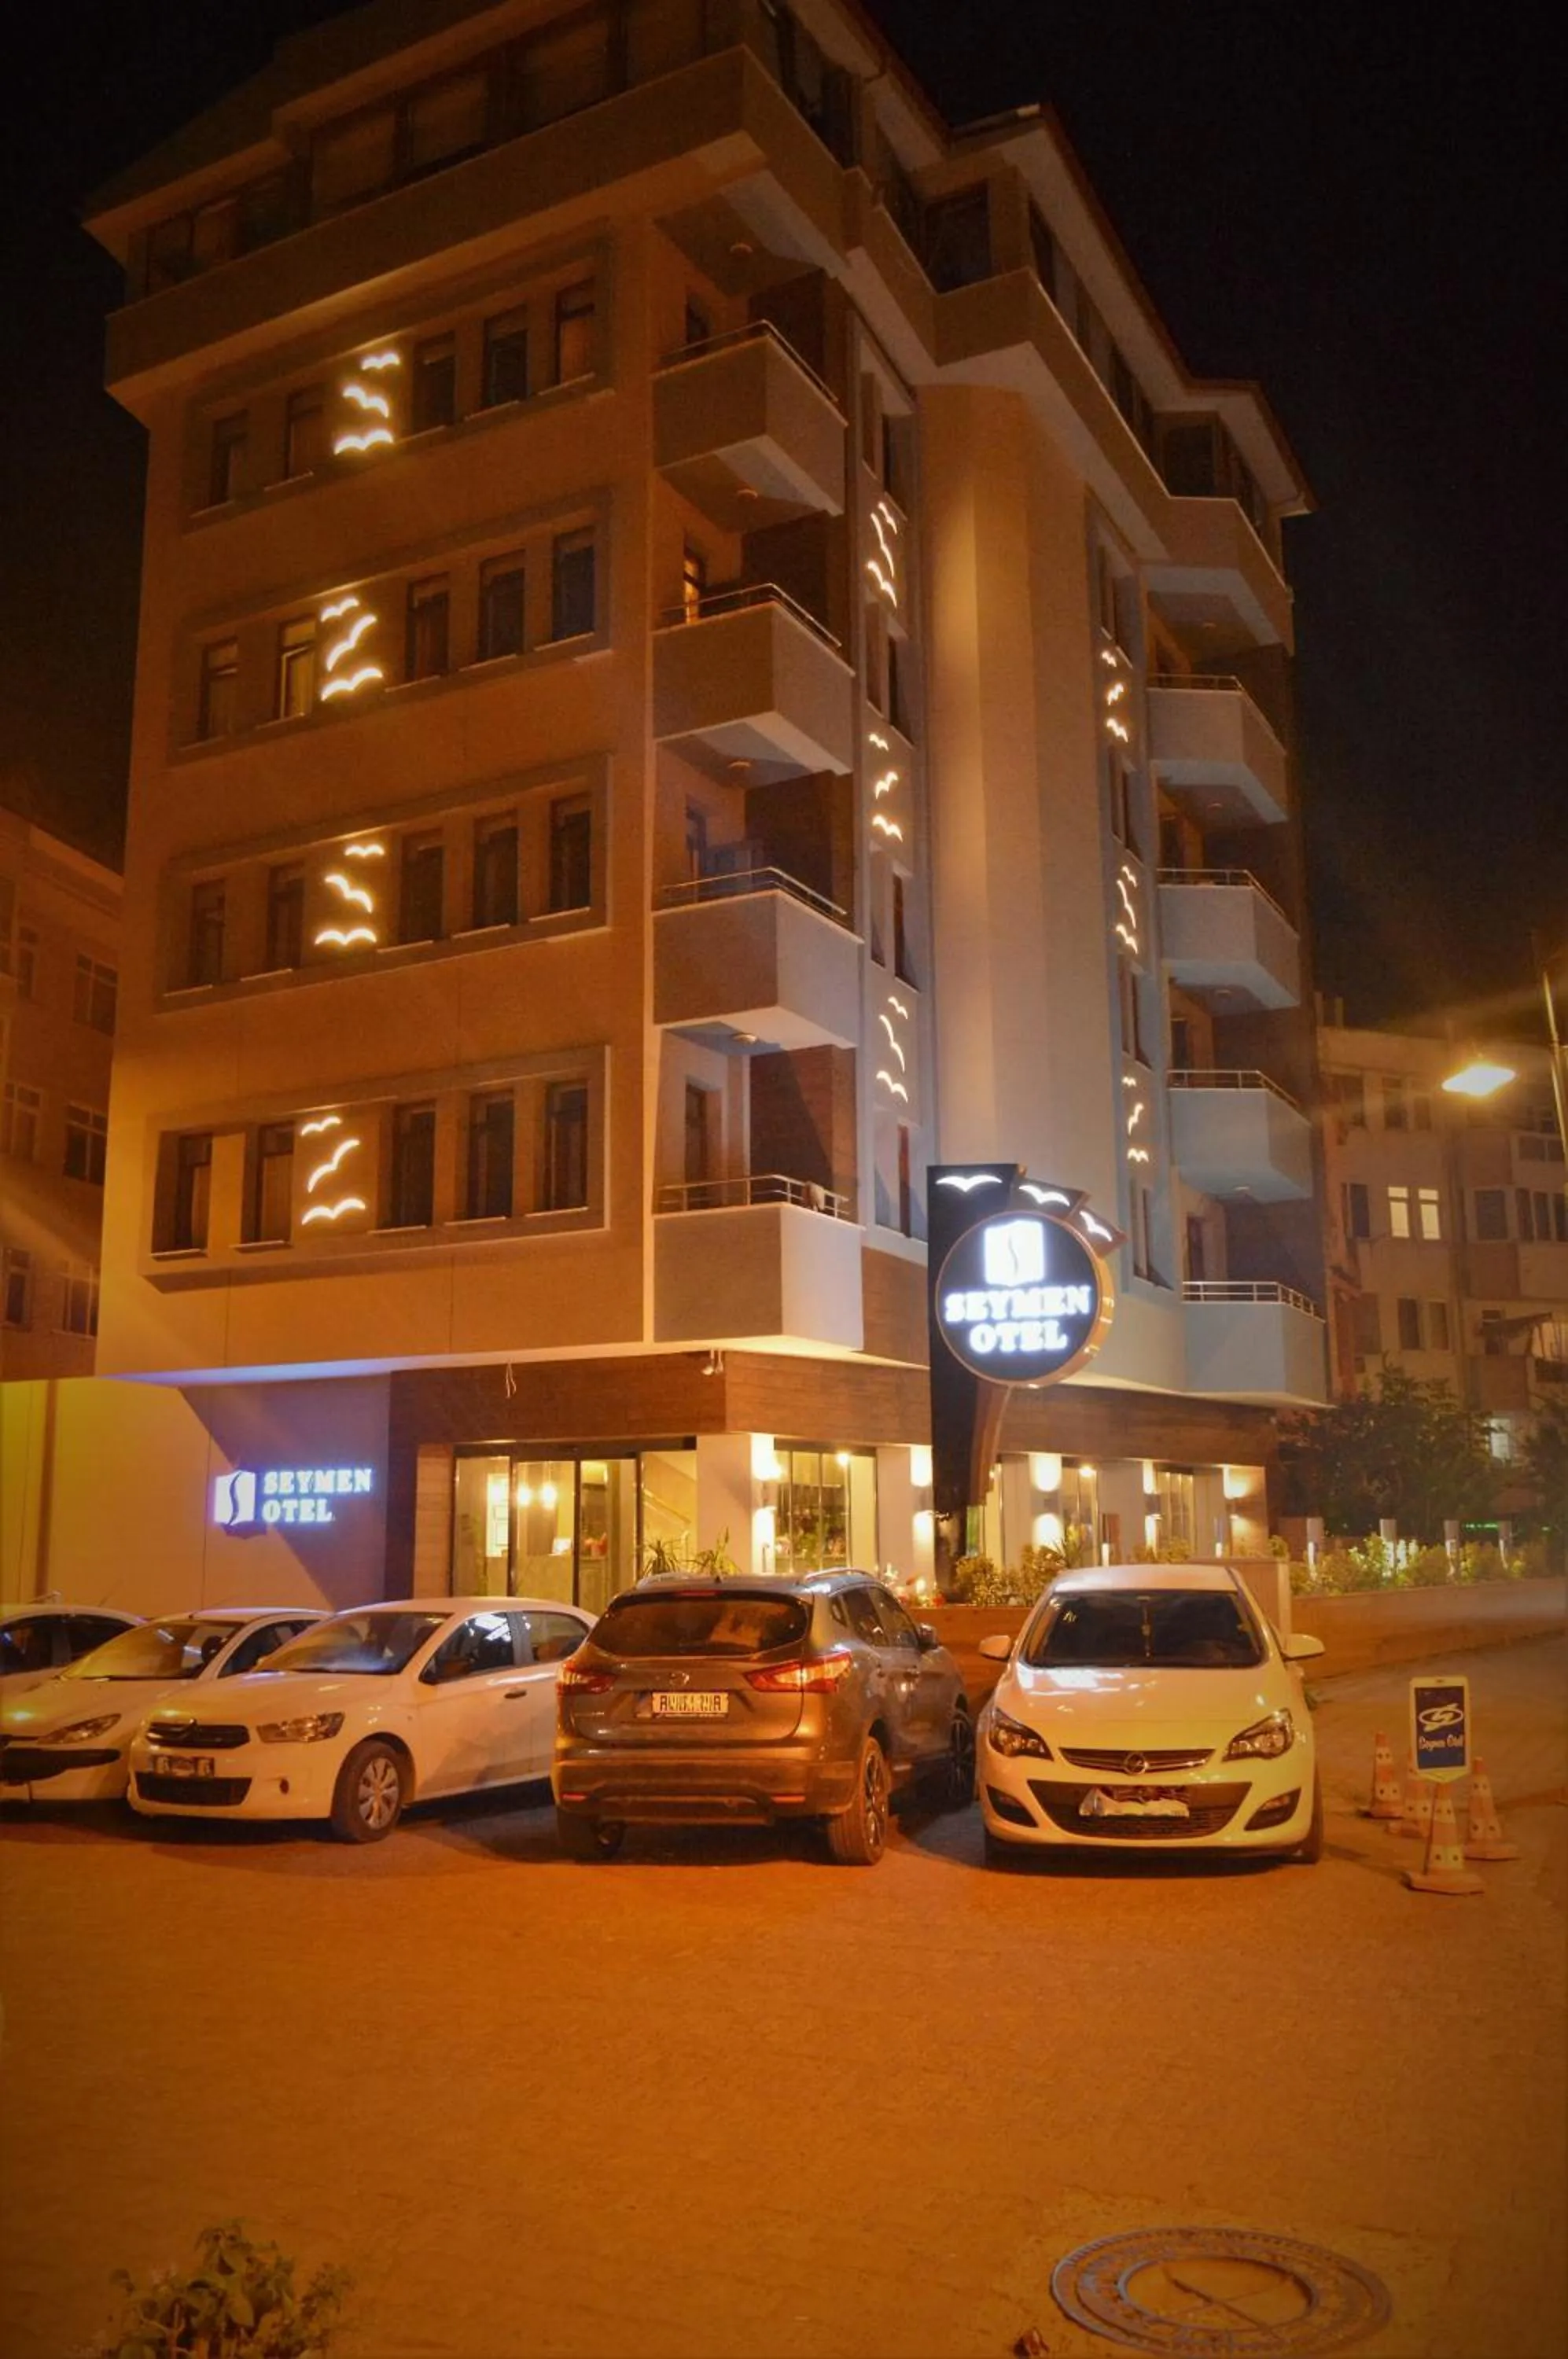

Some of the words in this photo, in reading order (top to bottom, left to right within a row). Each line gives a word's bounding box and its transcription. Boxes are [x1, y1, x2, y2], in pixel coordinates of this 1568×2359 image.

[944, 1286, 1090, 1322] SEYMEN
[969, 1321, 1068, 1352] OTEL
[263, 1469, 371, 1493] SEYMEN
[263, 1499, 333, 1522] OTEL
